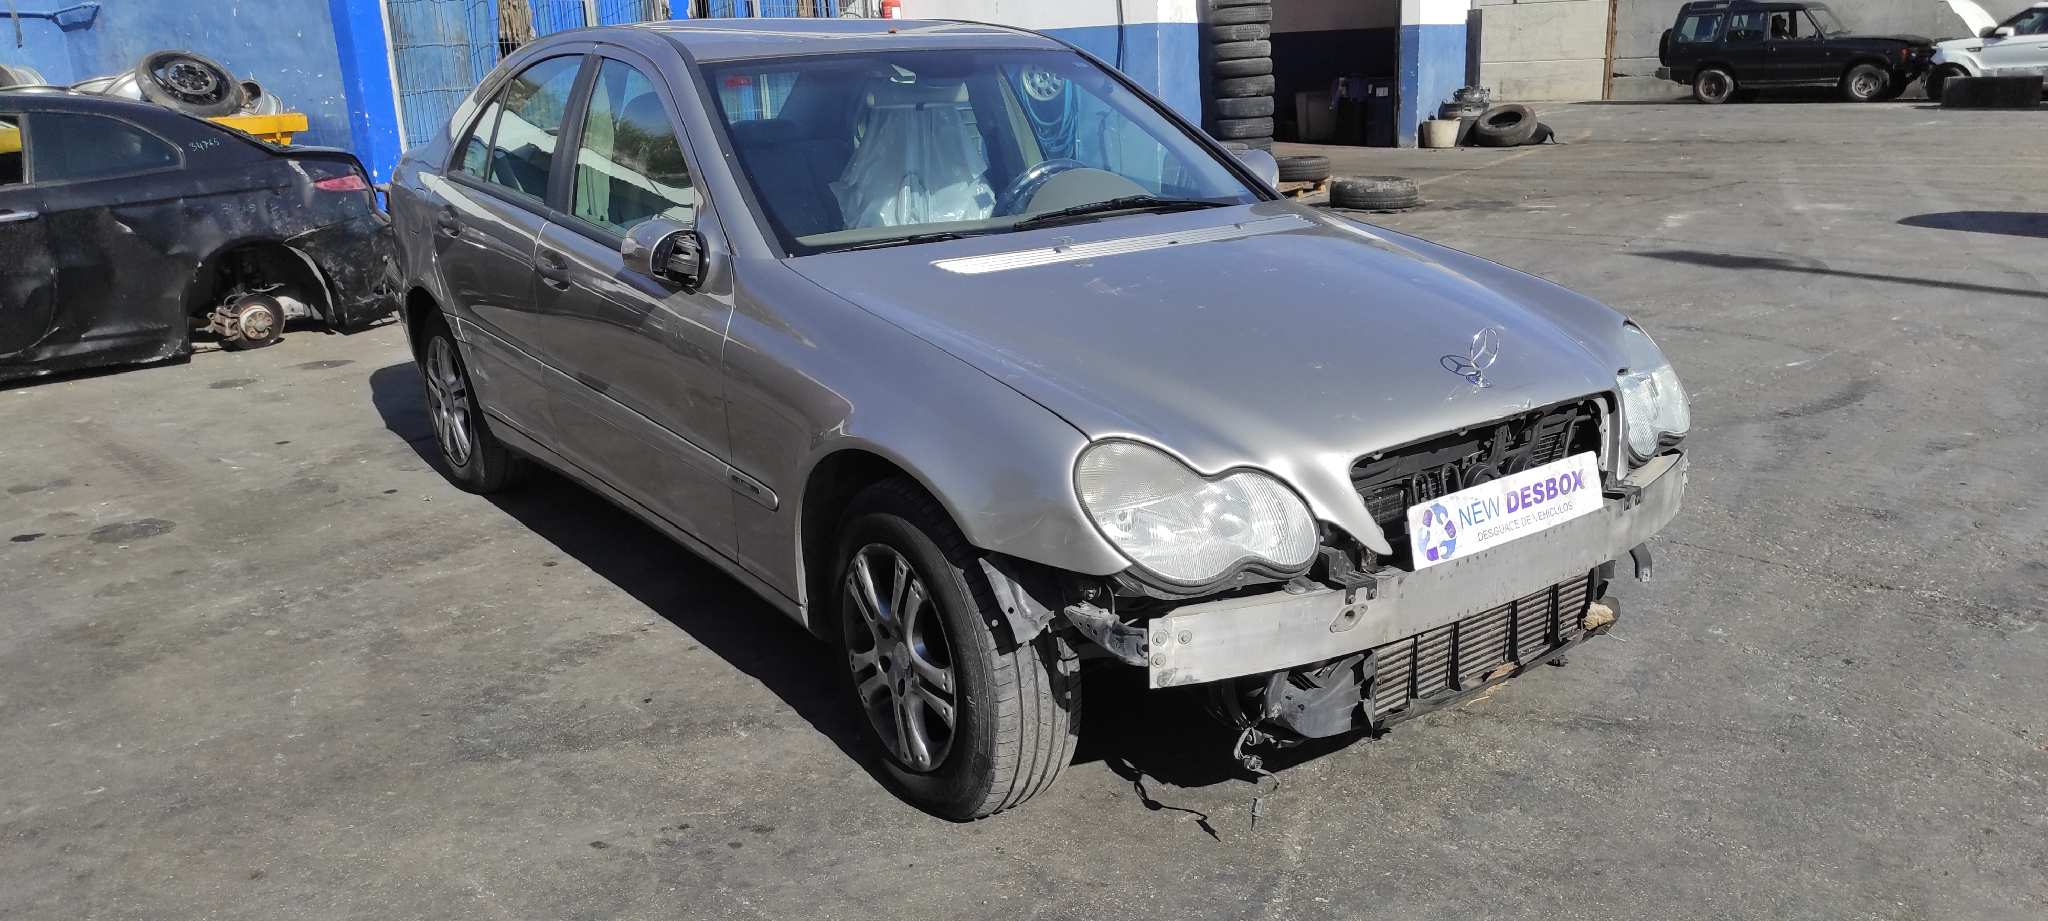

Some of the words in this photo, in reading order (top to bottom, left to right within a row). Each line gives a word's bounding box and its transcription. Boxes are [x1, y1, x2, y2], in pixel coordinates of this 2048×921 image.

[1506, 469, 1585, 514] DESBOX
[1477, 519, 1521, 542] DESGUACE
[1521, 514, 1532, 527] DE
